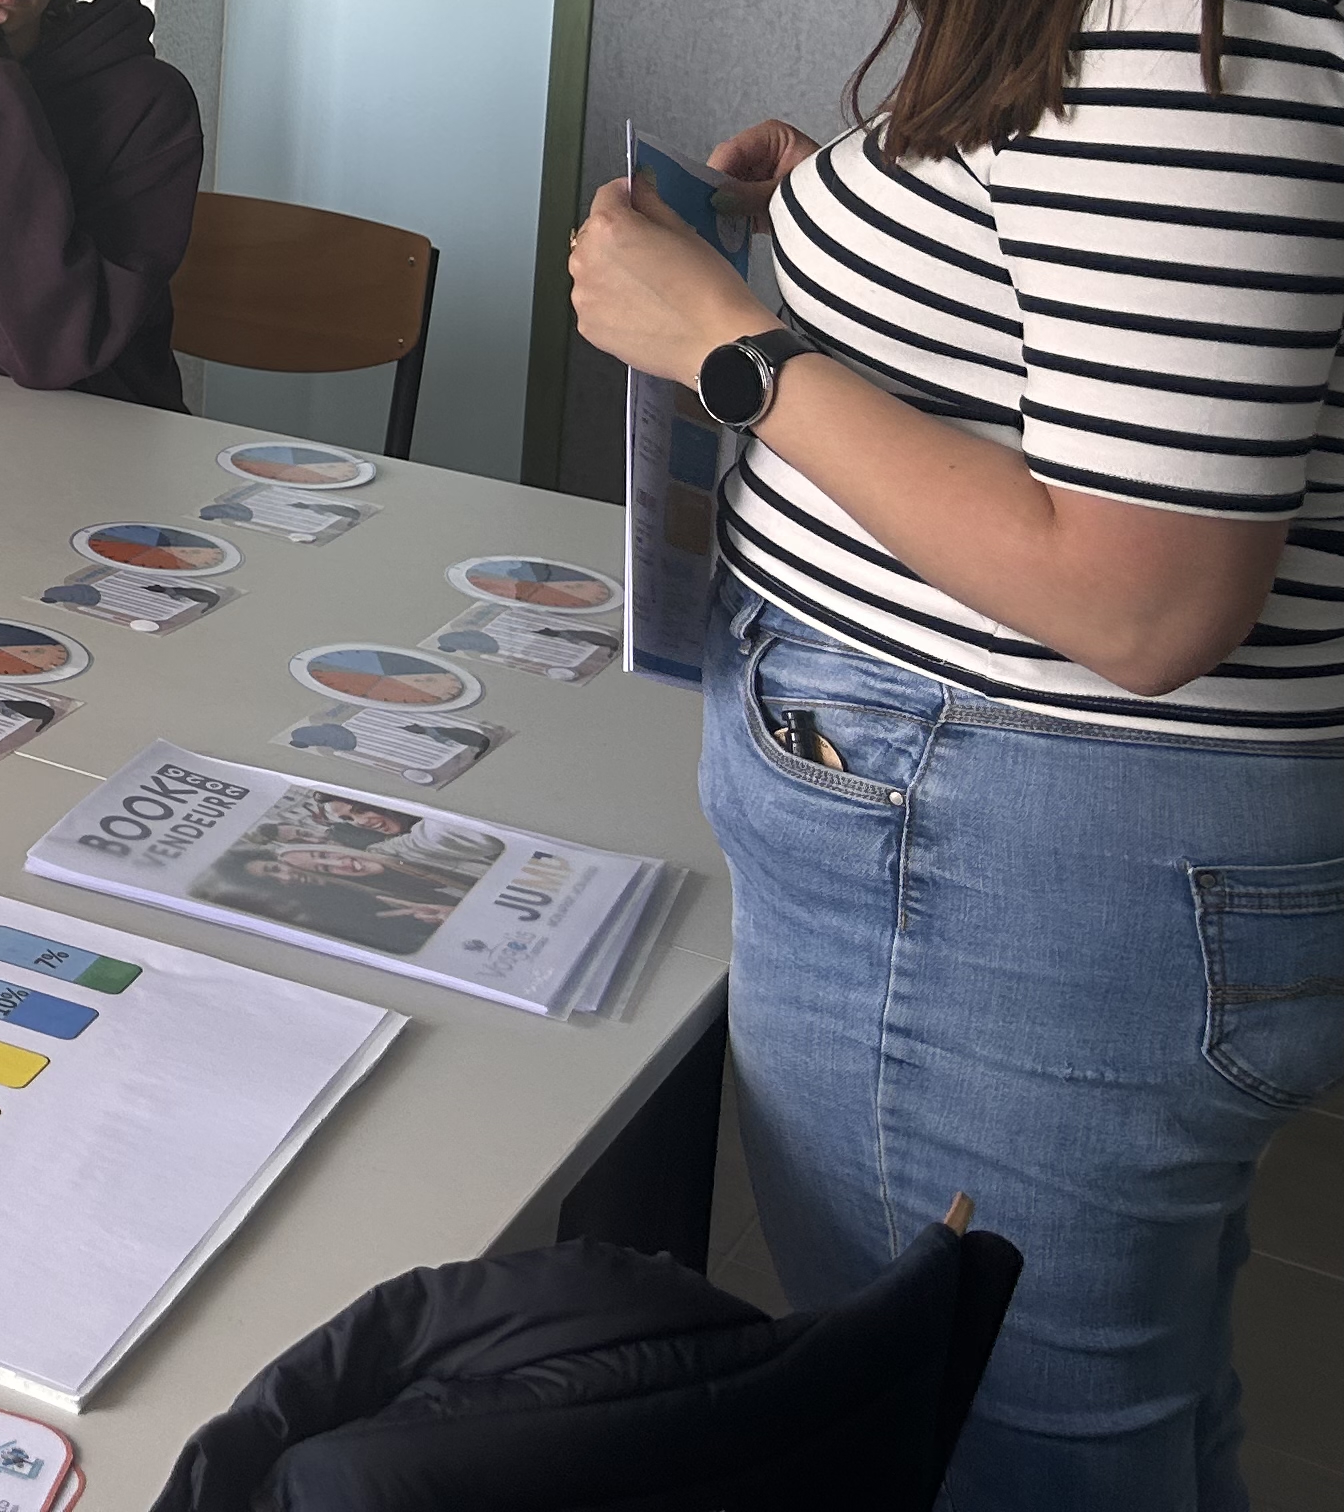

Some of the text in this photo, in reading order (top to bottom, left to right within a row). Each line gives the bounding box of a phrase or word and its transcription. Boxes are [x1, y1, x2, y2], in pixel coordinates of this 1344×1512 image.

[78, 766, 245, 857] BOOK 2026
[132, 796, 237, 867] VENDEUR
[34, 948, 70, 969] 7%
